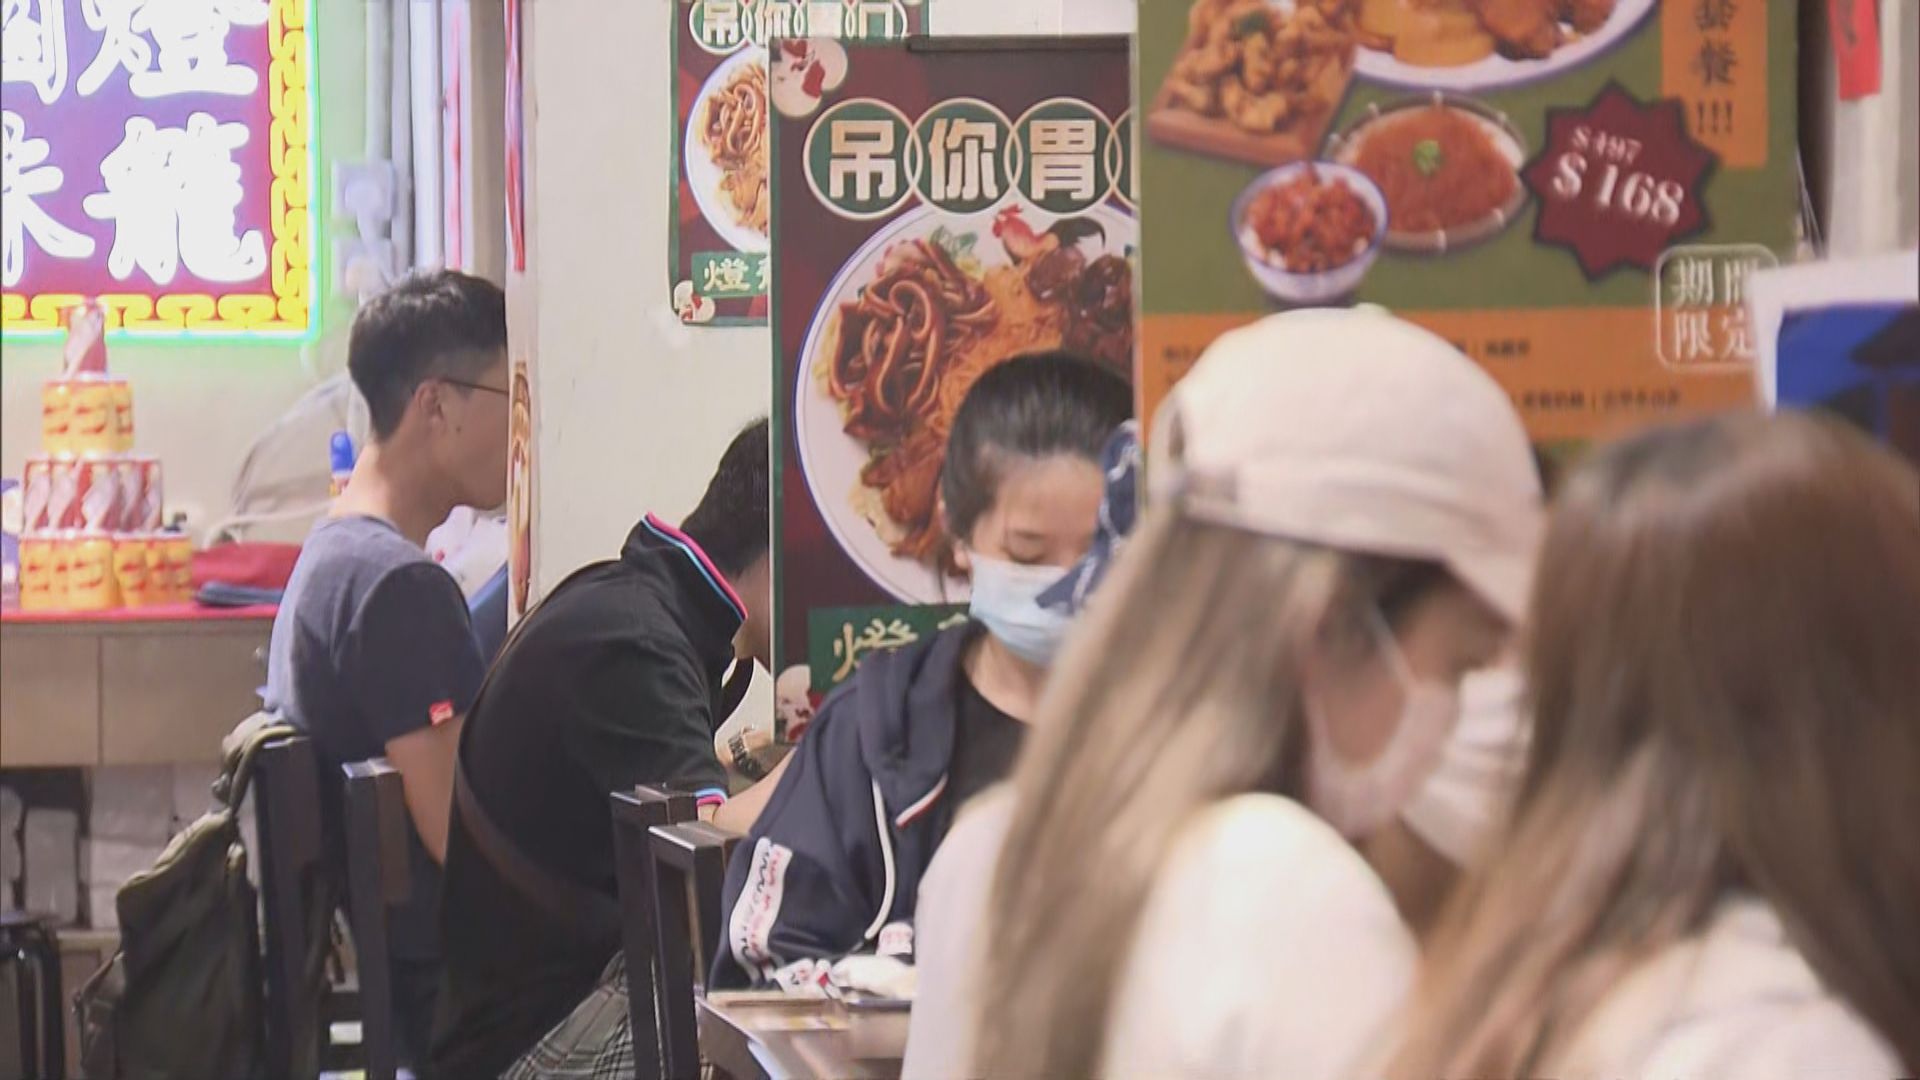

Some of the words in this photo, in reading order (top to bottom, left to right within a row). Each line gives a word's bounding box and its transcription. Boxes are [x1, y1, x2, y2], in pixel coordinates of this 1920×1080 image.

[76, 0, 268, 286] 燈籠
[829, 117, 1140, 202] 吊你胃
[702, 256, 768, 292] 燈
